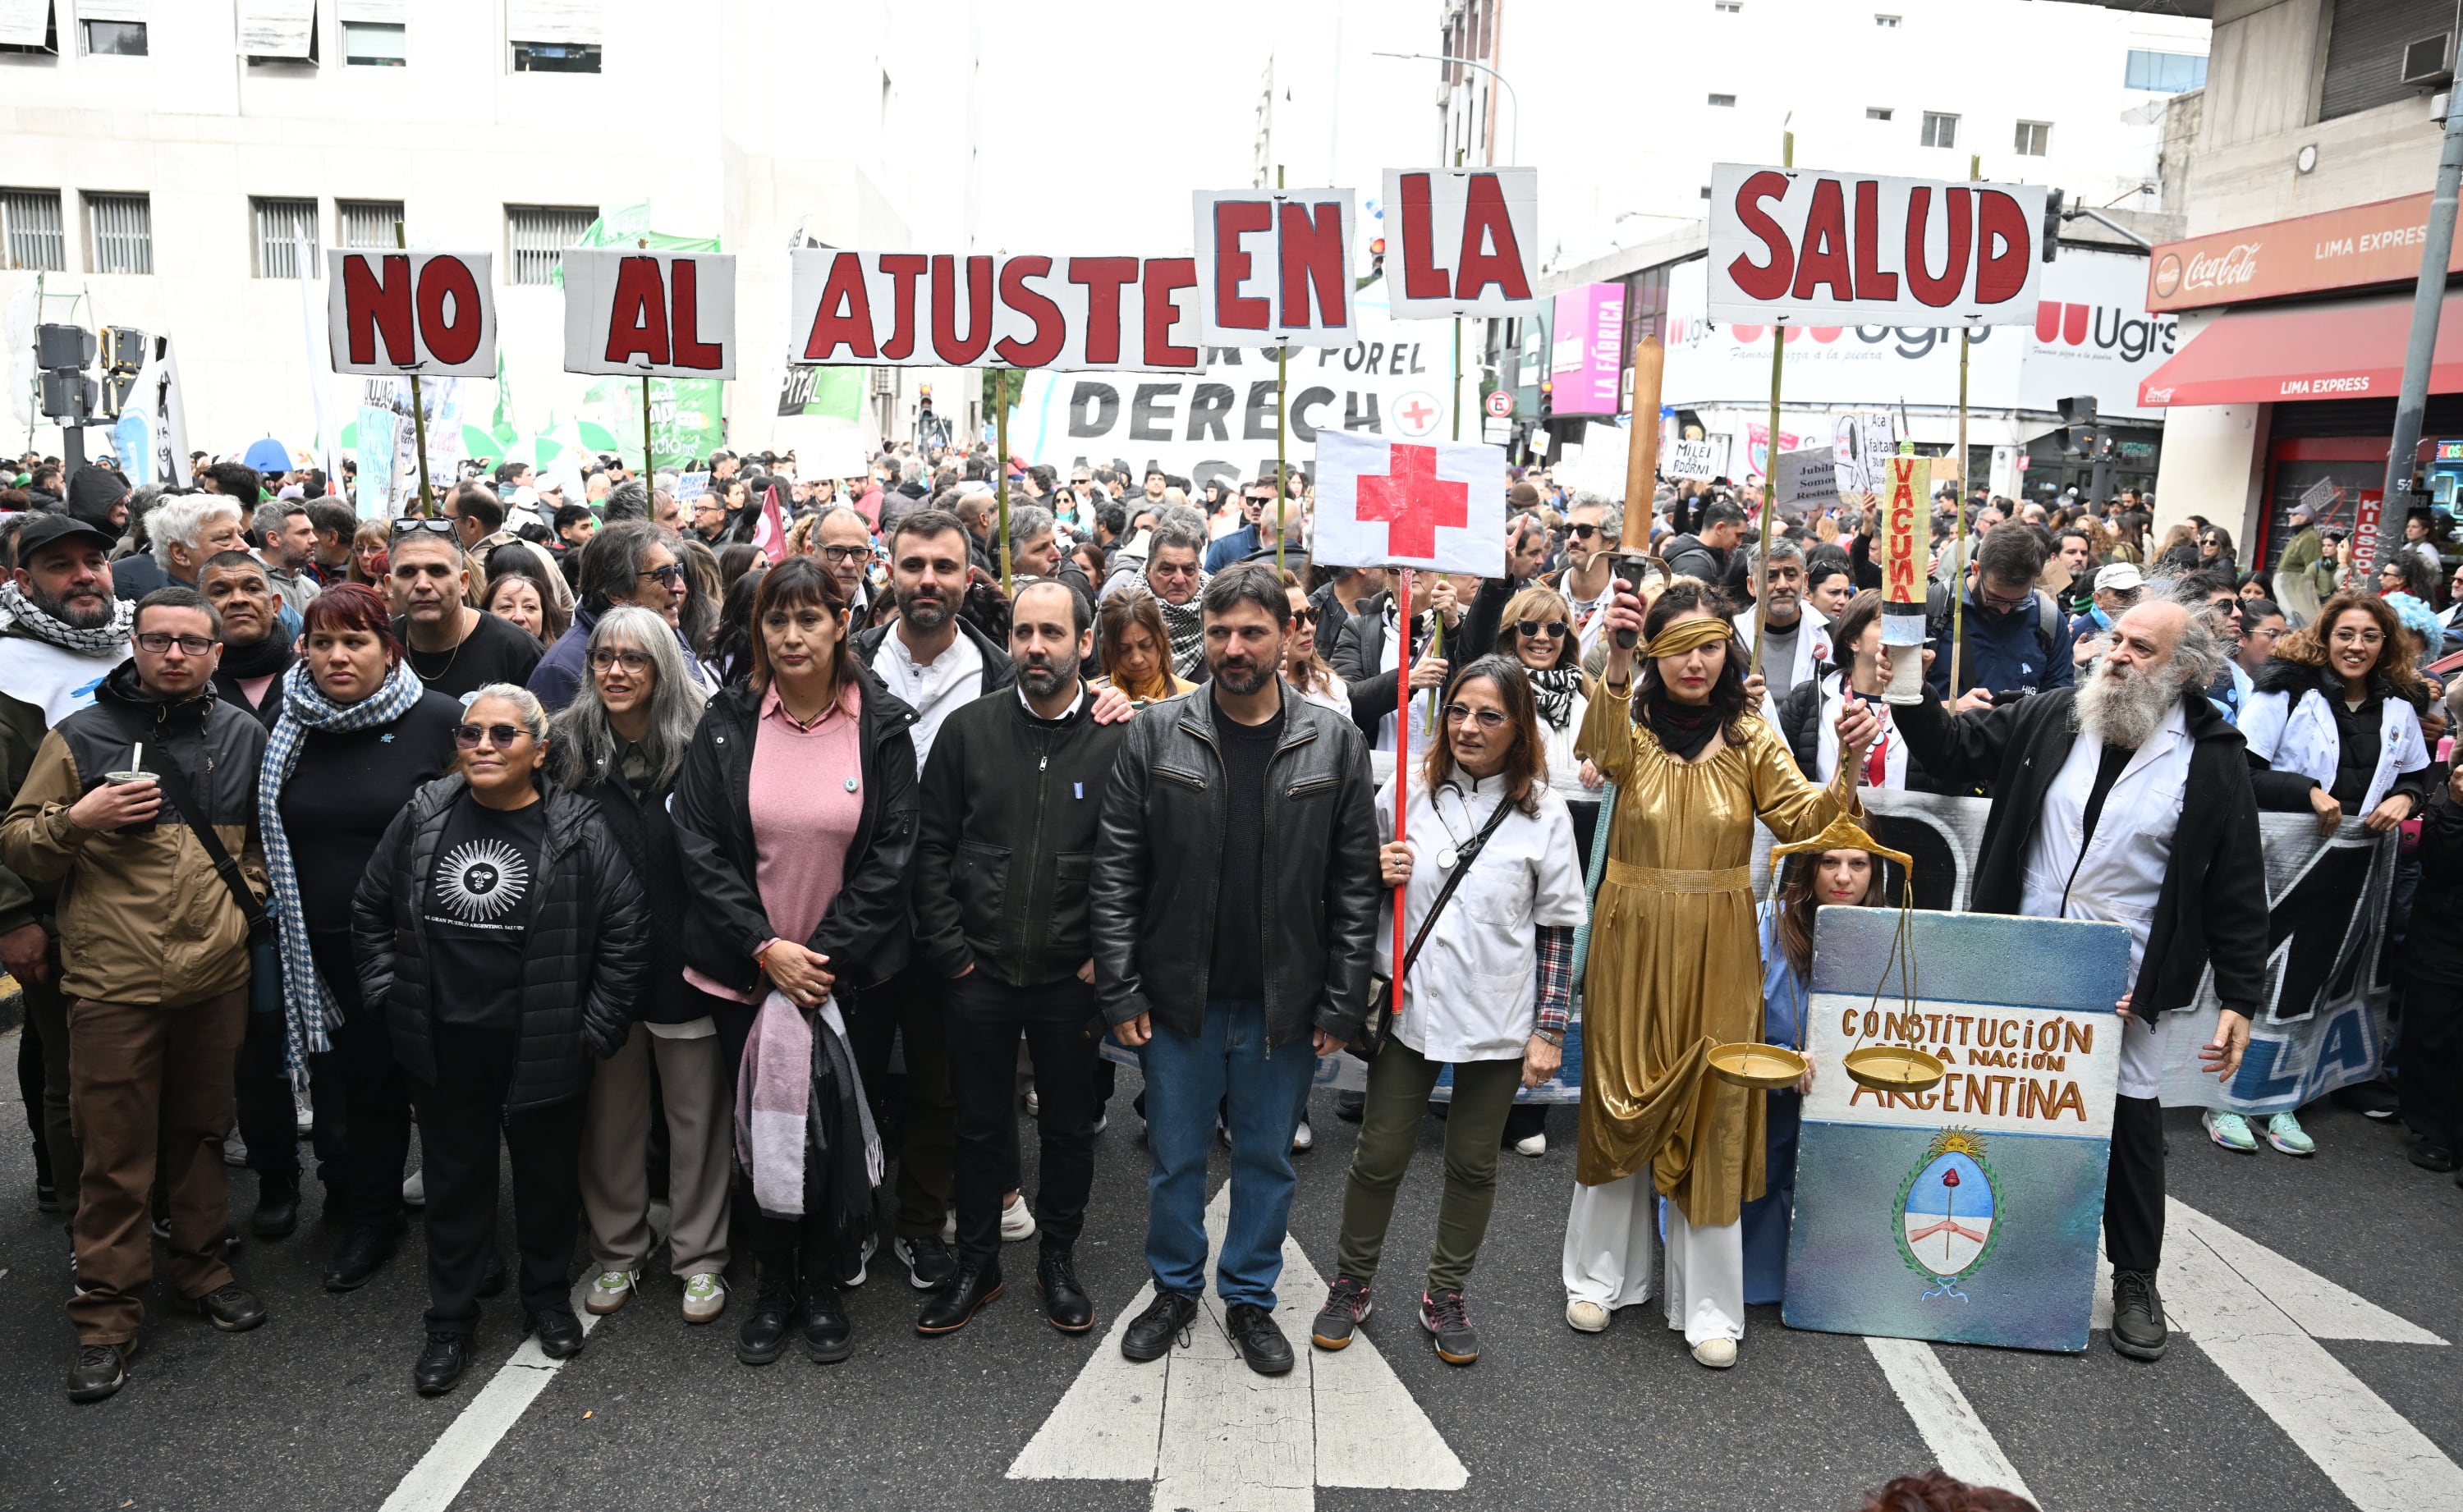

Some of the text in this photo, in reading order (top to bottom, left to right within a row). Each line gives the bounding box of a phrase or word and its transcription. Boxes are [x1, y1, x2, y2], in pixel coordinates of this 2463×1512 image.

[1214, 200, 1347, 330] EN
[1400, 172, 1532, 301] LA
[1728, 170, 2030, 307] SALUD
[2184, 242, 2262, 291] Coca-Cola
[2315, 225, 2428, 260] LIMA EXPRES
[342, 254, 483, 365] NO
[605, 256, 722, 369] AL
[804, 252, 1198, 367] AJUSTE
[1319, 347, 1383, 374] POR
[1390, 342, 1425, 374] EL
[1591, 300, 1622, 399] LA FÁBRICA
[782, 370, 821, 404] PITAL
[2281, 377, 2369, 395] LIMA EXPRESS
[1800, 464, 1835, 476] Jubila
[1869, 438, 1894, 452] faltan
[1800, 478, 1836, 488] Somos
[2355, 499, 2381, 570] KIOSCO
